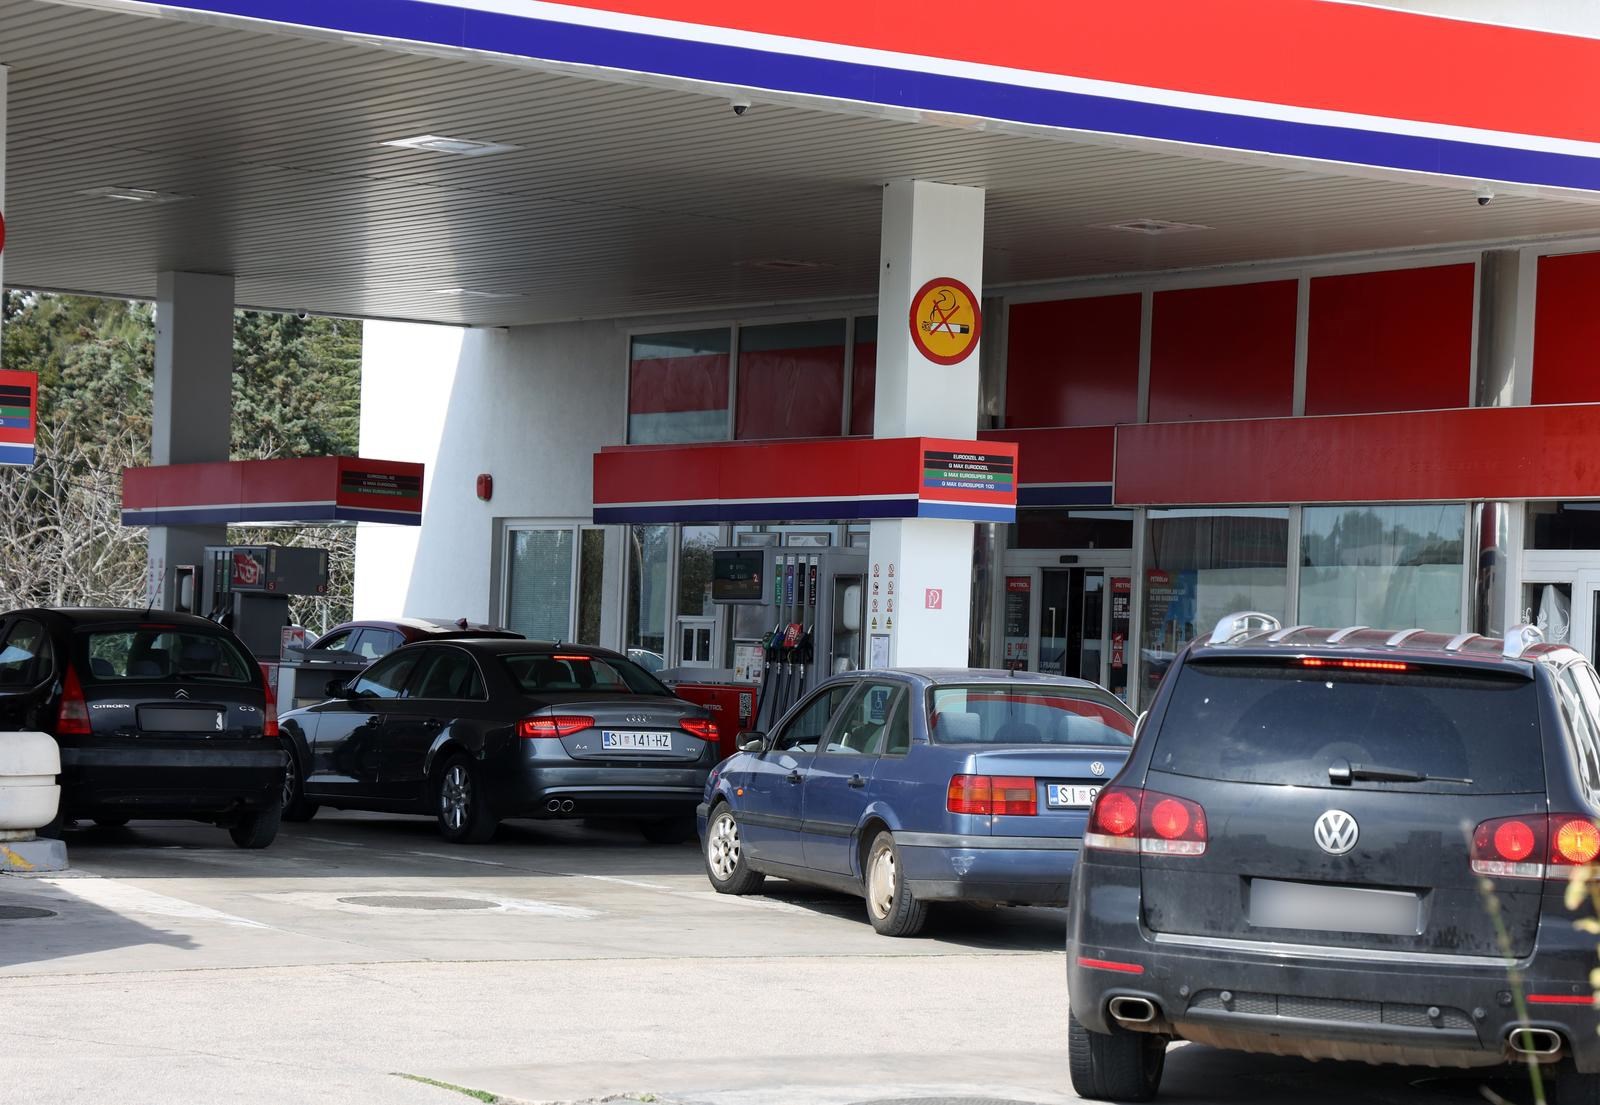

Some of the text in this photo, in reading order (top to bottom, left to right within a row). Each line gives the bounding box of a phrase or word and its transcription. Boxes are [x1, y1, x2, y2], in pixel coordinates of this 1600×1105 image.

[753, 573, 759, 582] 2
[611, 734, 669, 747] SI 141-HZ
[1060, 787, 1075, 803] SI
